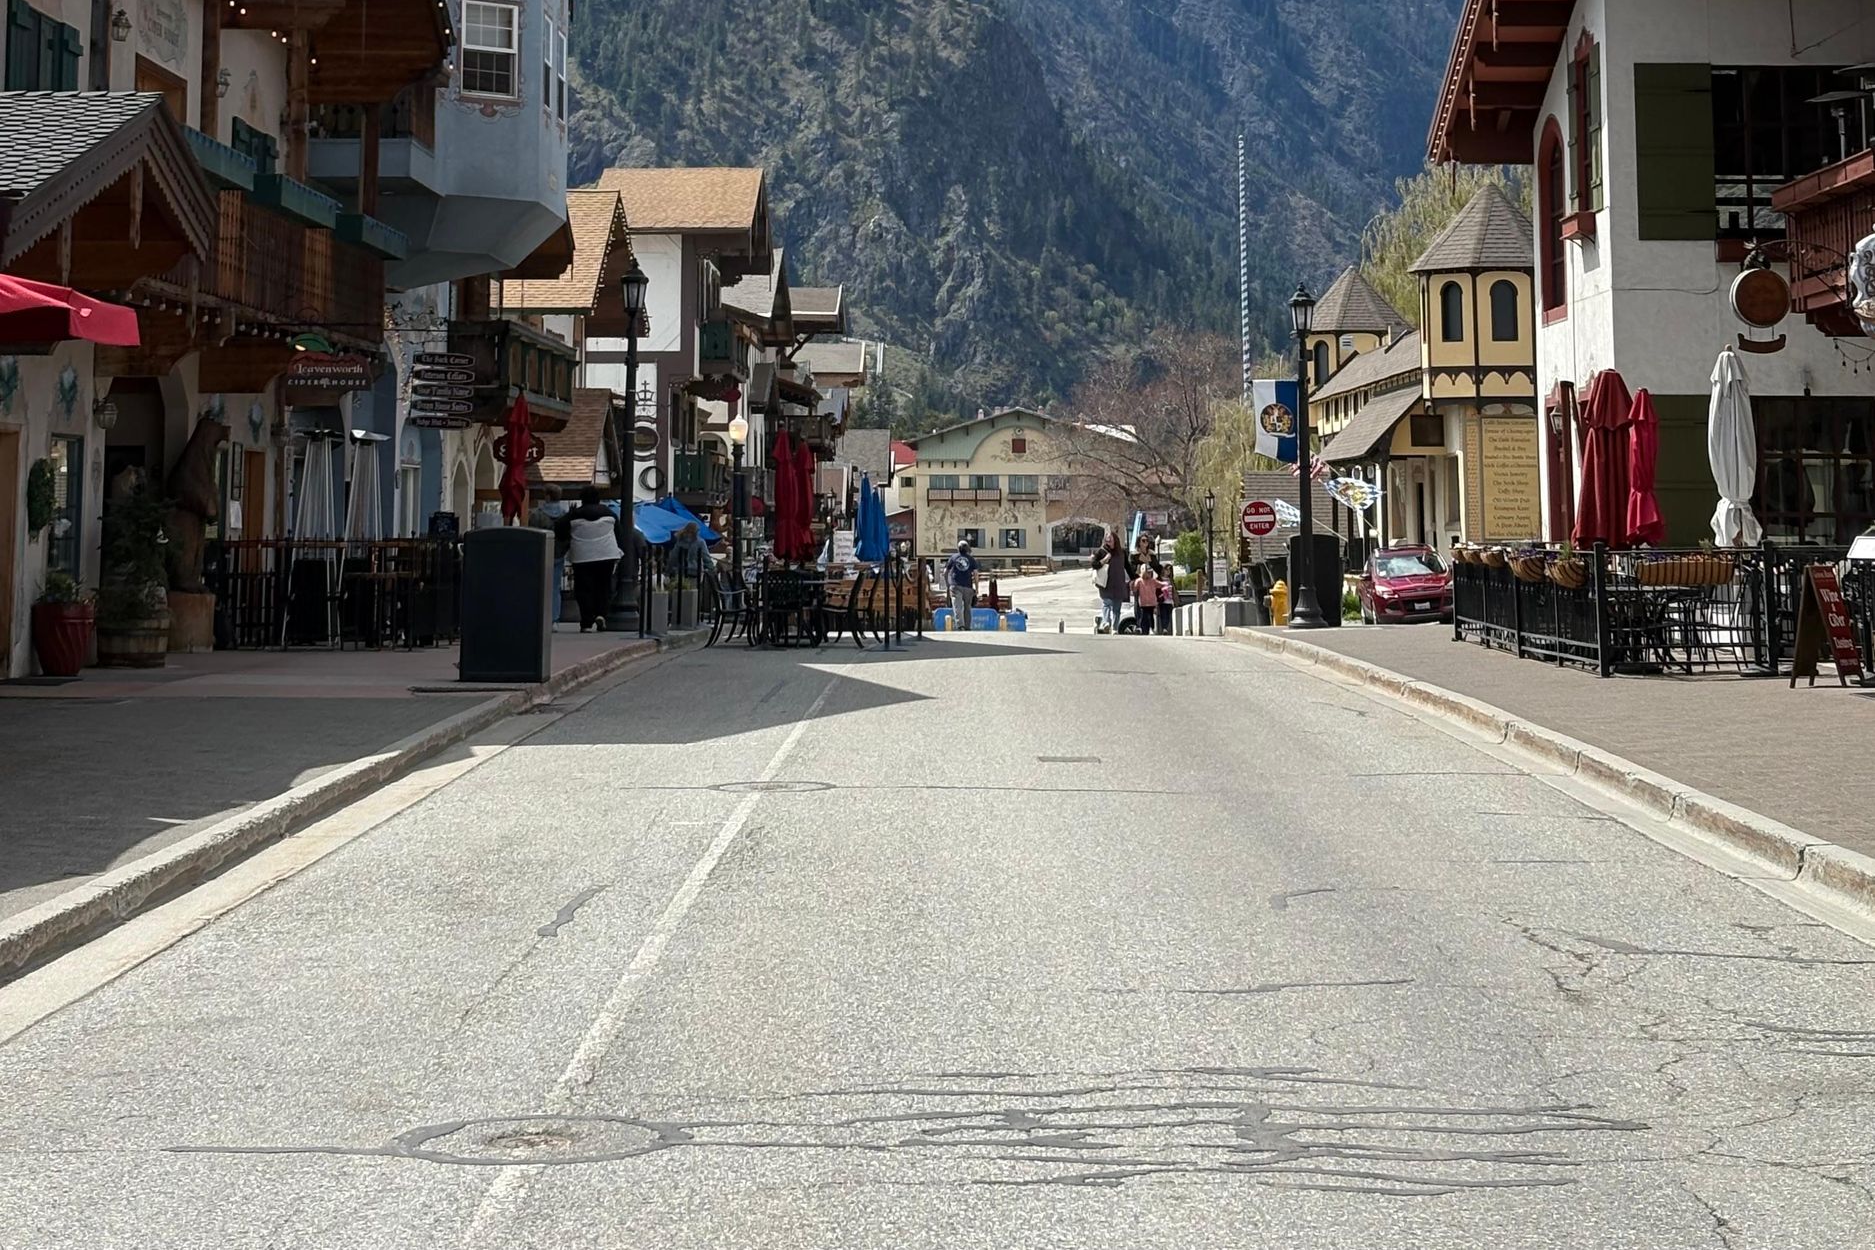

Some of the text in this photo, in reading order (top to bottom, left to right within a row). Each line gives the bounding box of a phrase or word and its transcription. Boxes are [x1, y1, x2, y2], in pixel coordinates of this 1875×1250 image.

[294, 363, 363, 375] Leavenworth
[287, 378, 367, 386] CIDER HOUSE
[1250, 522, 1270, 530] ENTER
[1820, 589, 1840, 603] Wine
[1828, 612, 1846, 628] Cider
[1833, 636, 1854, 650] Tasting
